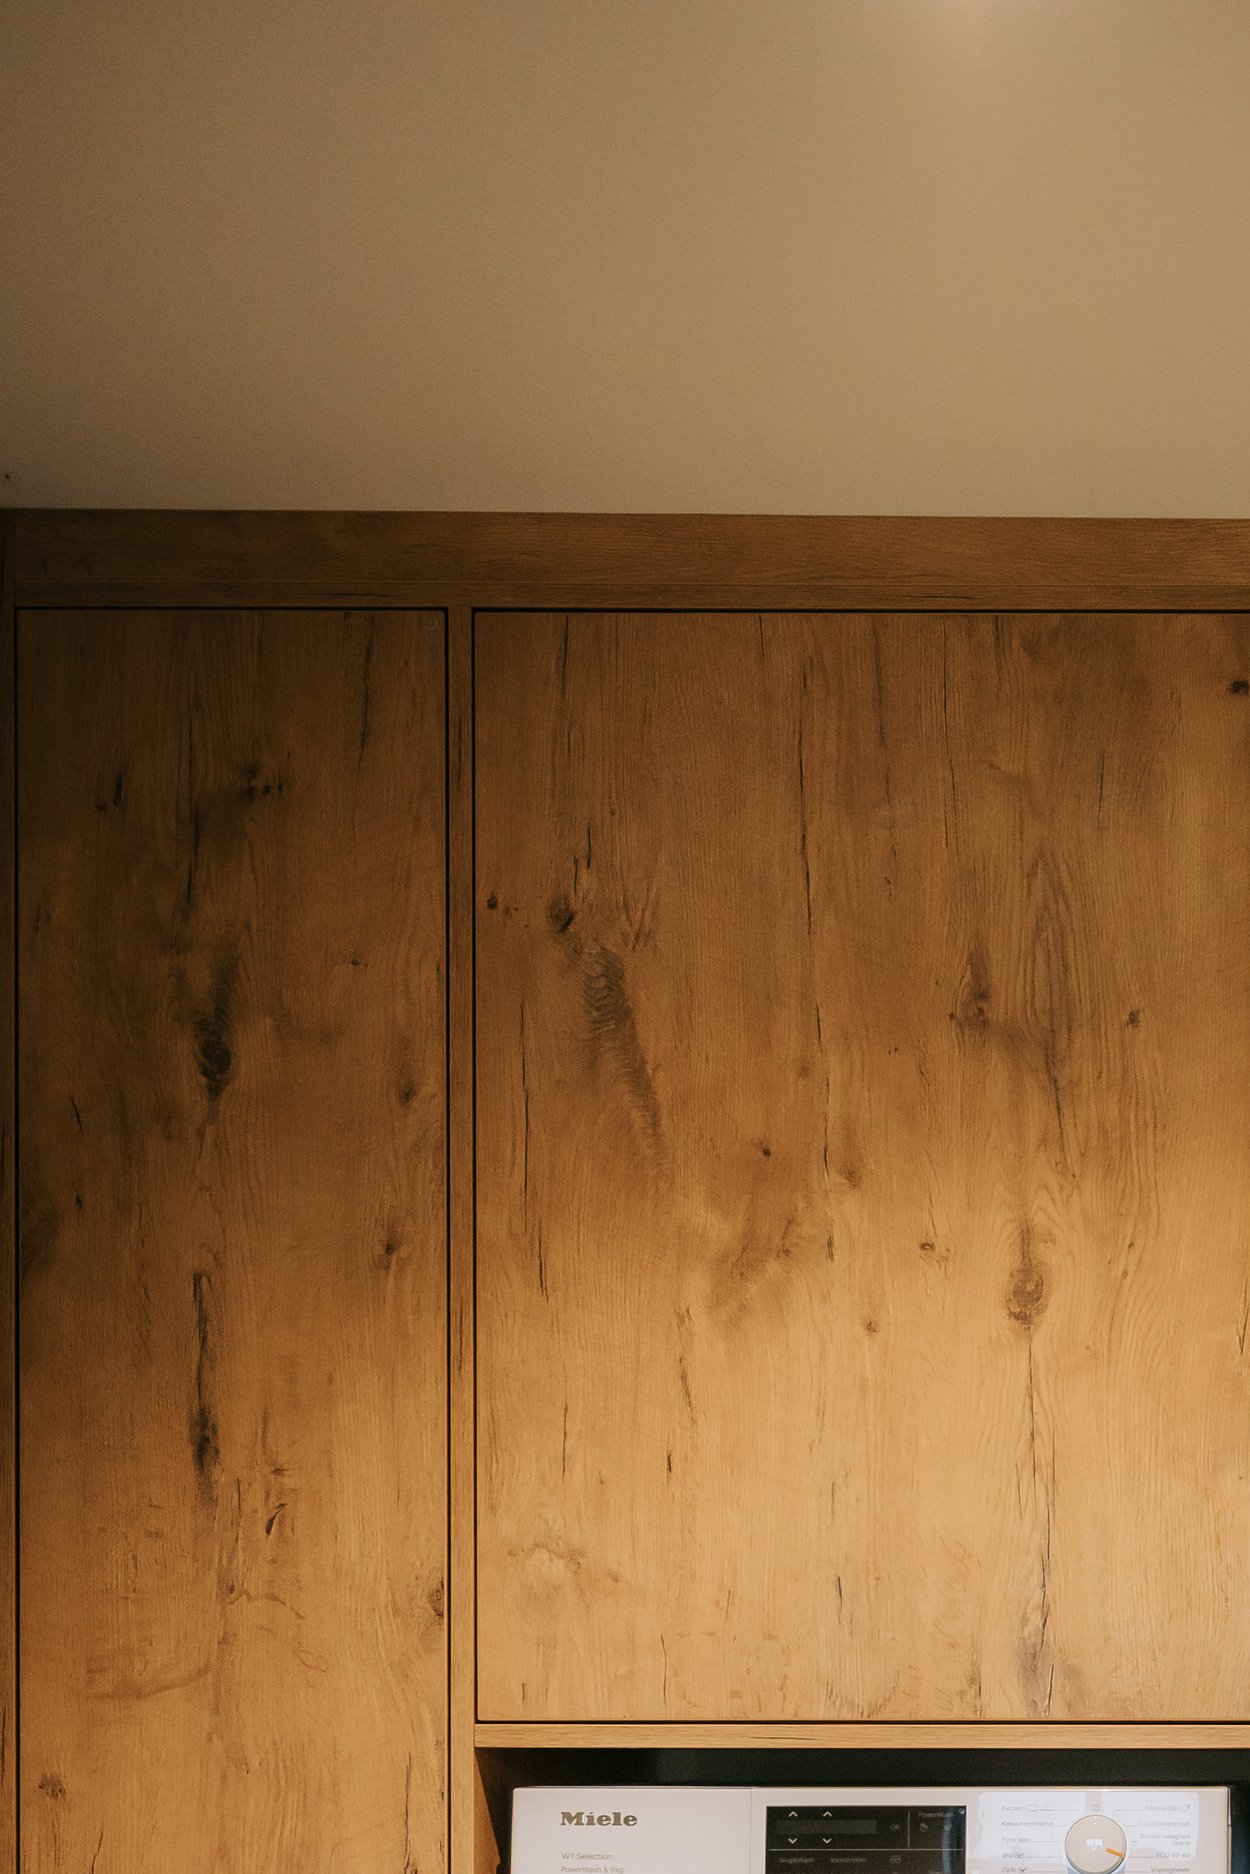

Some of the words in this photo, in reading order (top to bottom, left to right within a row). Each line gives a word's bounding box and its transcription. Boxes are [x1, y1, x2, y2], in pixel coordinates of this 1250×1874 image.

[560, 1811, 639, 1827] Miele
[561, 1852, 574, 1861] W1
[576, 1852, 614, 1861] Selection
[561, 1866, 602, 1874] PowerWash
[603, 1866, 609, 1874] &
